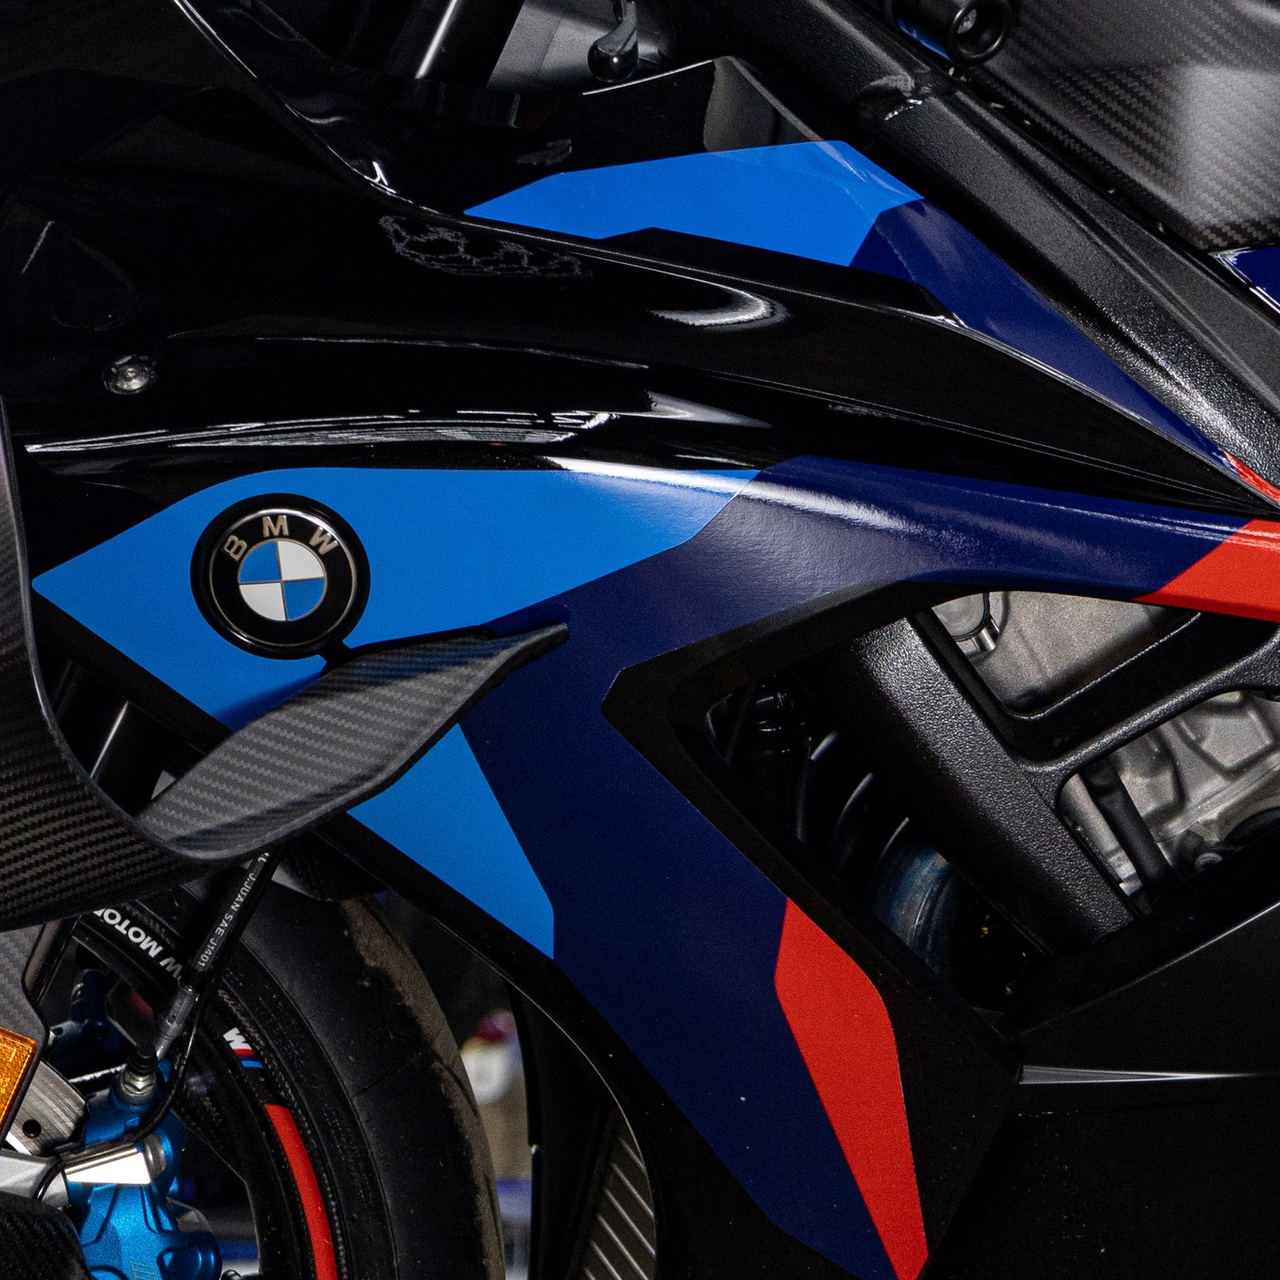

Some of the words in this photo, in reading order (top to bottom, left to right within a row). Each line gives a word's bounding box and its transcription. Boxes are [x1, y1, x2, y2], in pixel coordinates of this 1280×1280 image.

[223, 515, 338, 562] BMW
[215, 913, 233, 936] SAE
[197, 937, 218, 967] J1401
